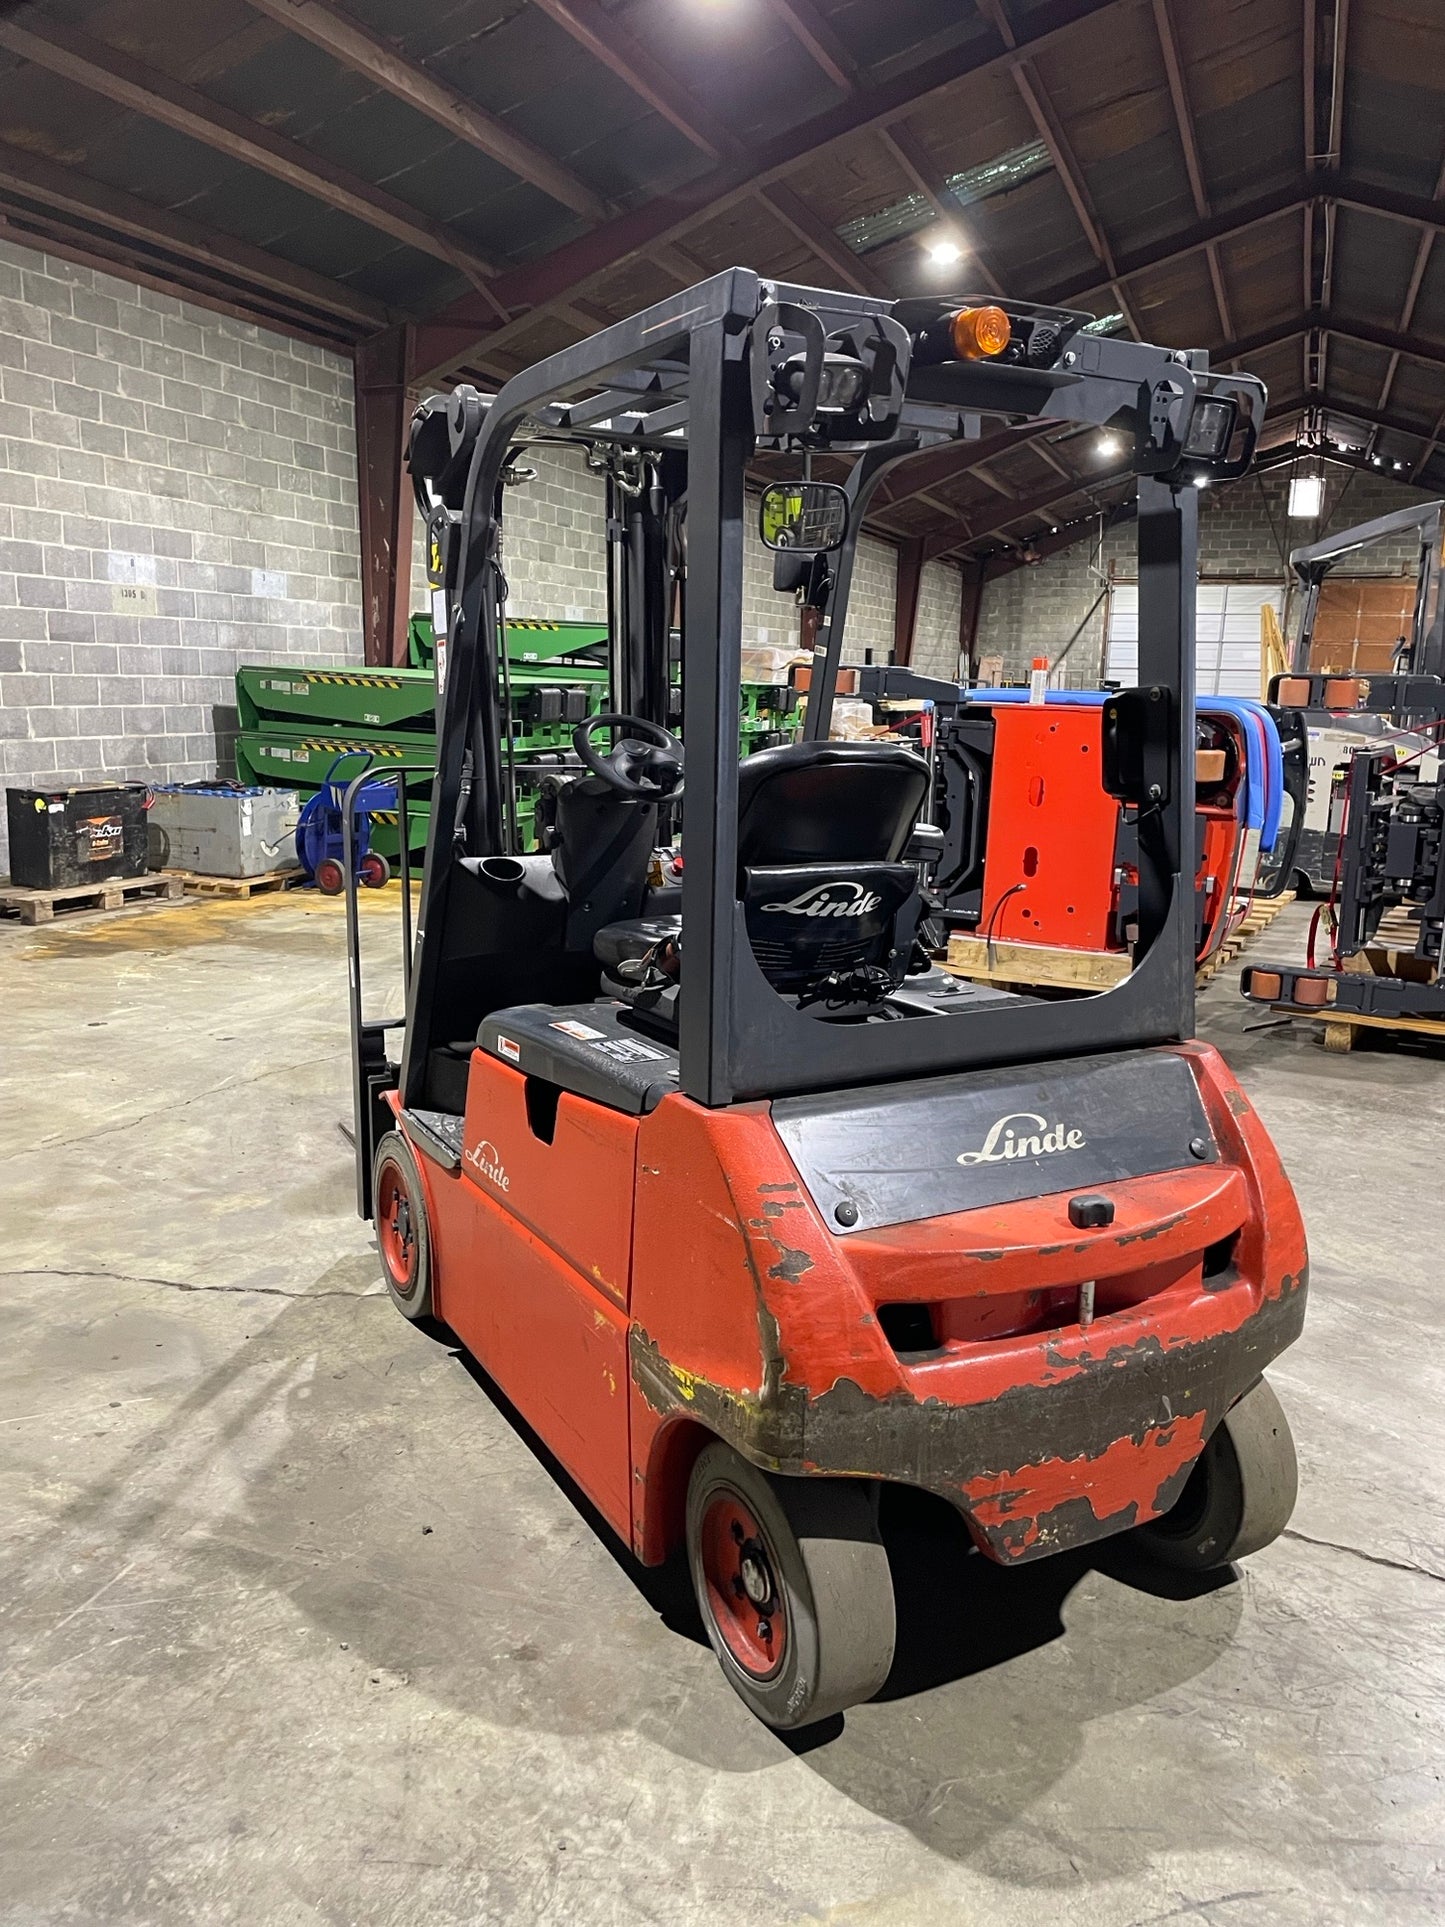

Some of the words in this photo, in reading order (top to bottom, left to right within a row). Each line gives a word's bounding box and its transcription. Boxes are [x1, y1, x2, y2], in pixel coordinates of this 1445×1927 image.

[760, 881, 882, 918] Linde
[956, 1112, 1087, 1166] Linde
[465, 1140, 510, 1192] Linde
